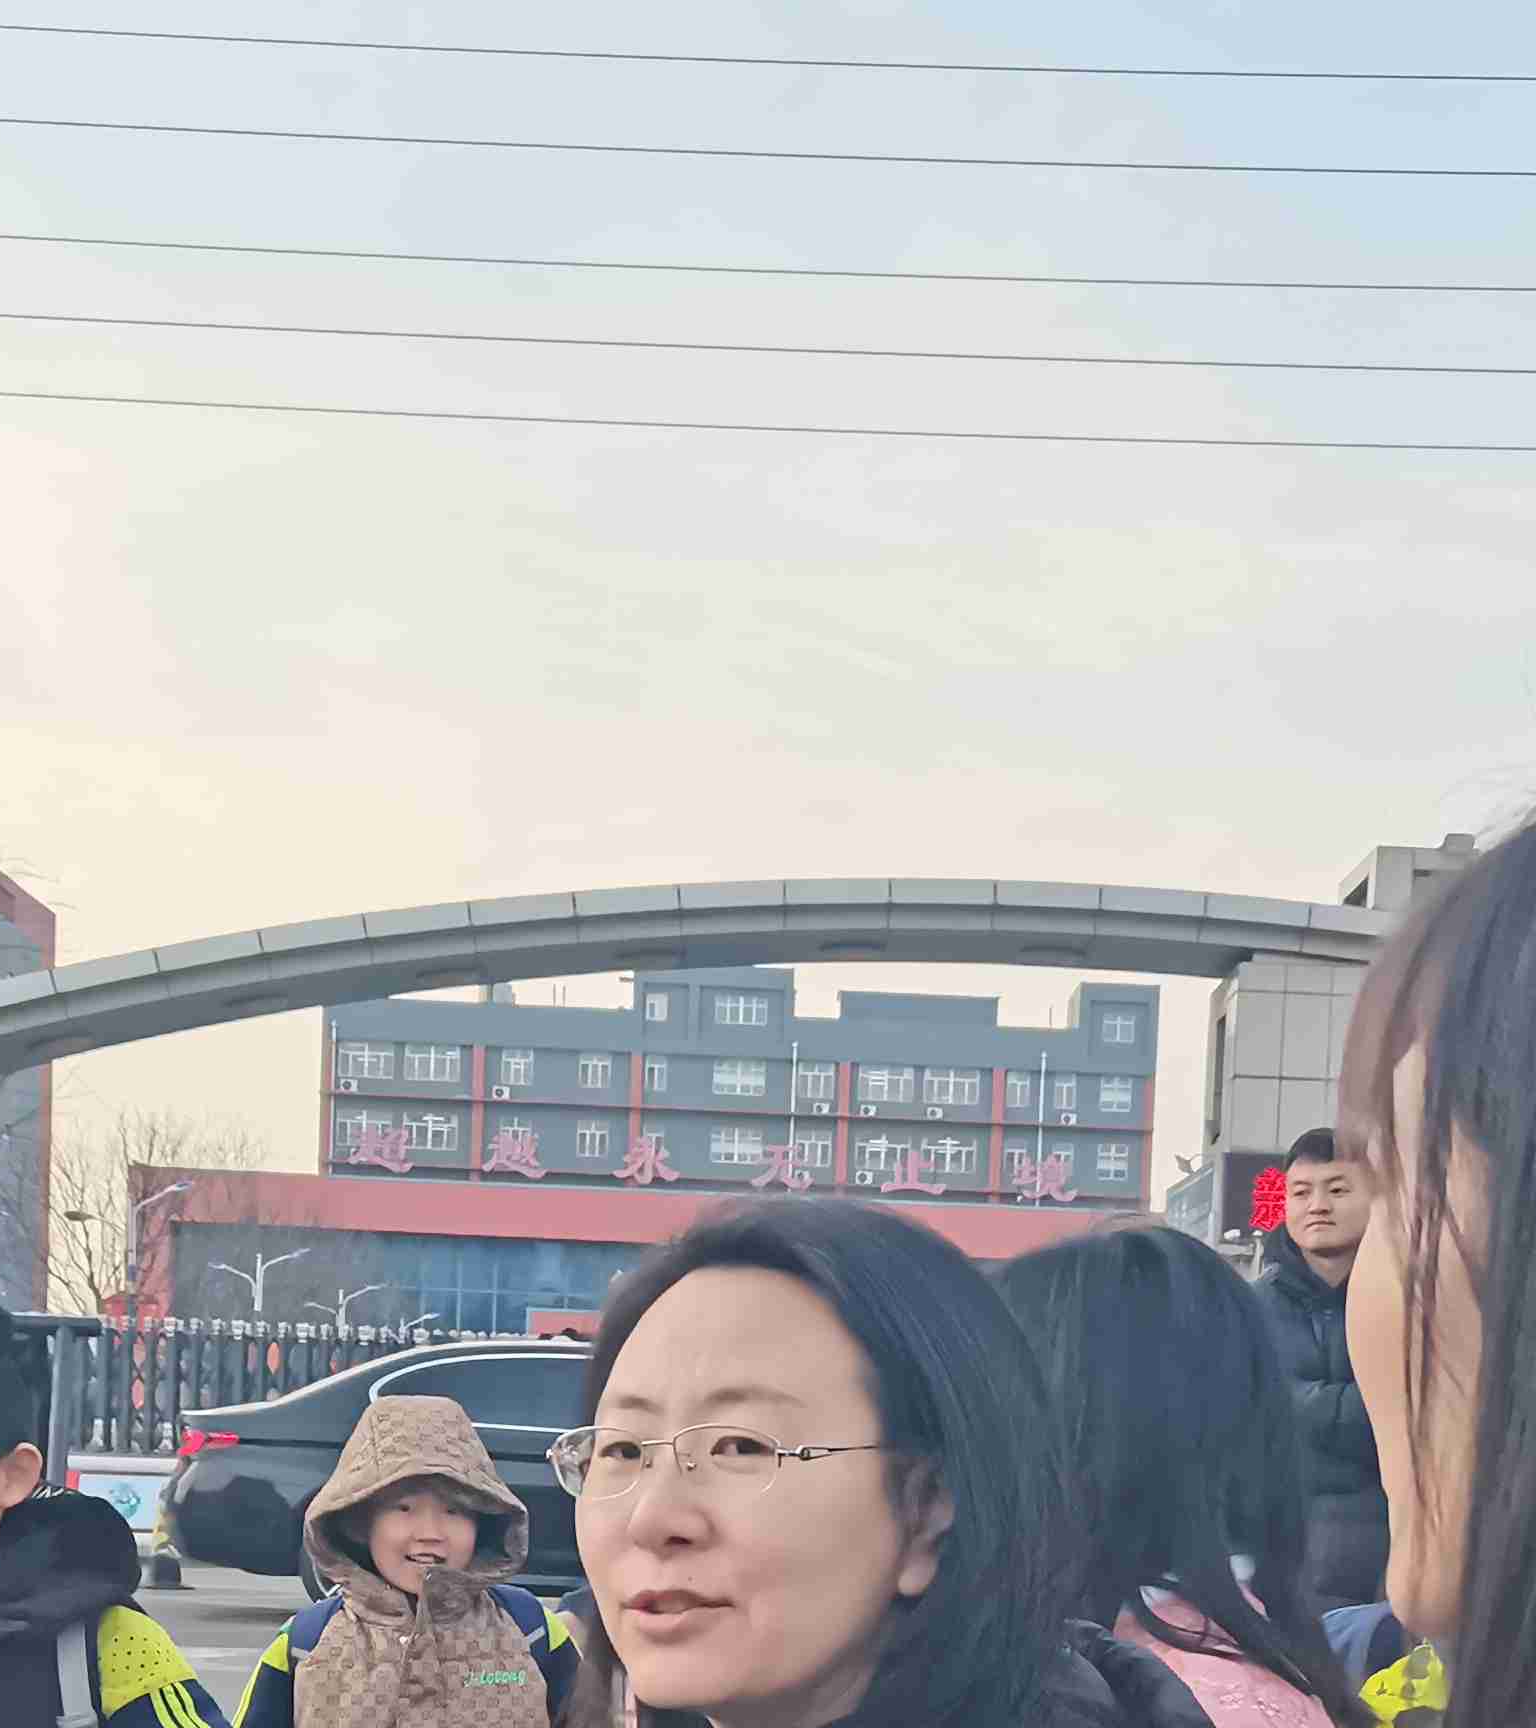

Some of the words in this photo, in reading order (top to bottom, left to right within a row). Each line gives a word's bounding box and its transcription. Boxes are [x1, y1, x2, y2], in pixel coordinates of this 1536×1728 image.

[348, 1126, 1078, 1202] 超越永无止境
